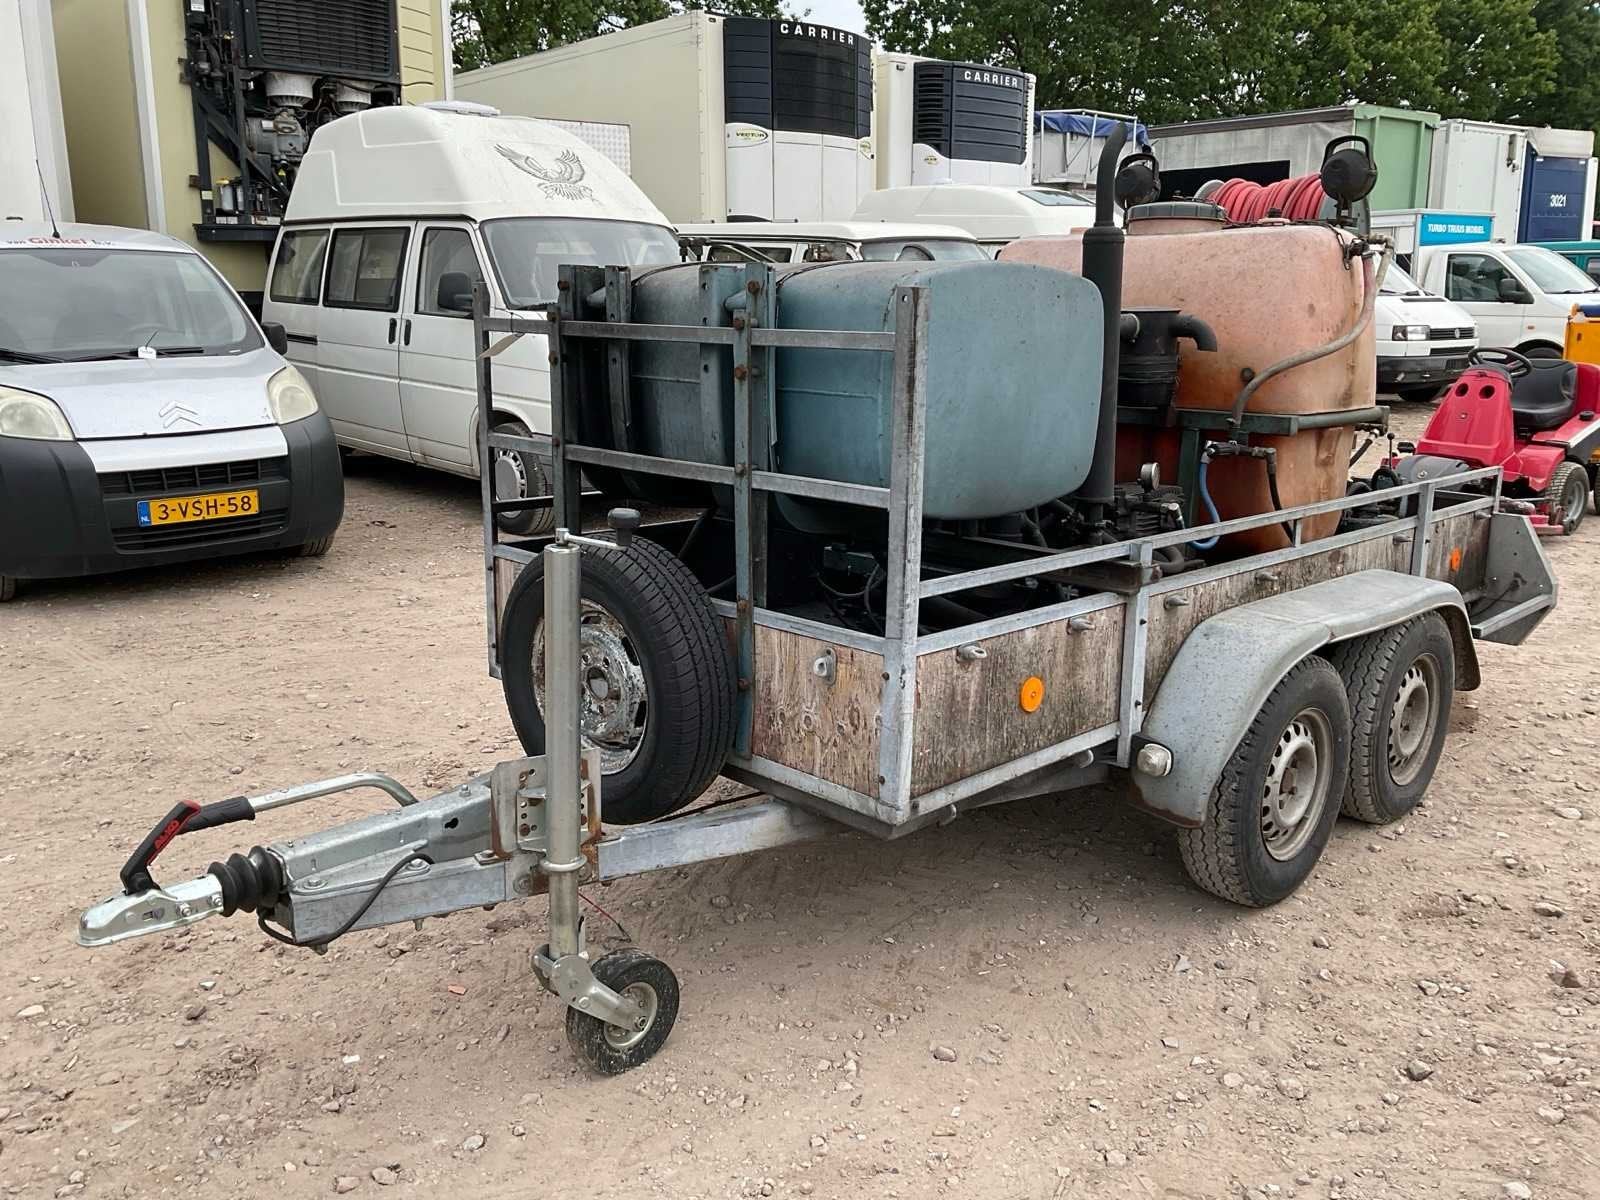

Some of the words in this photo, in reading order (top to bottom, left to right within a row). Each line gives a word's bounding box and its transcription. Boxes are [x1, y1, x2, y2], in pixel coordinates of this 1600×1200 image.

[780, 23, 854, 46] CARRIER
[964, 70, 1018, 89] CARRIER
[1550, 194, 1567, 208] 3021
[158, 495, 252, 520] 3-VSH-58
